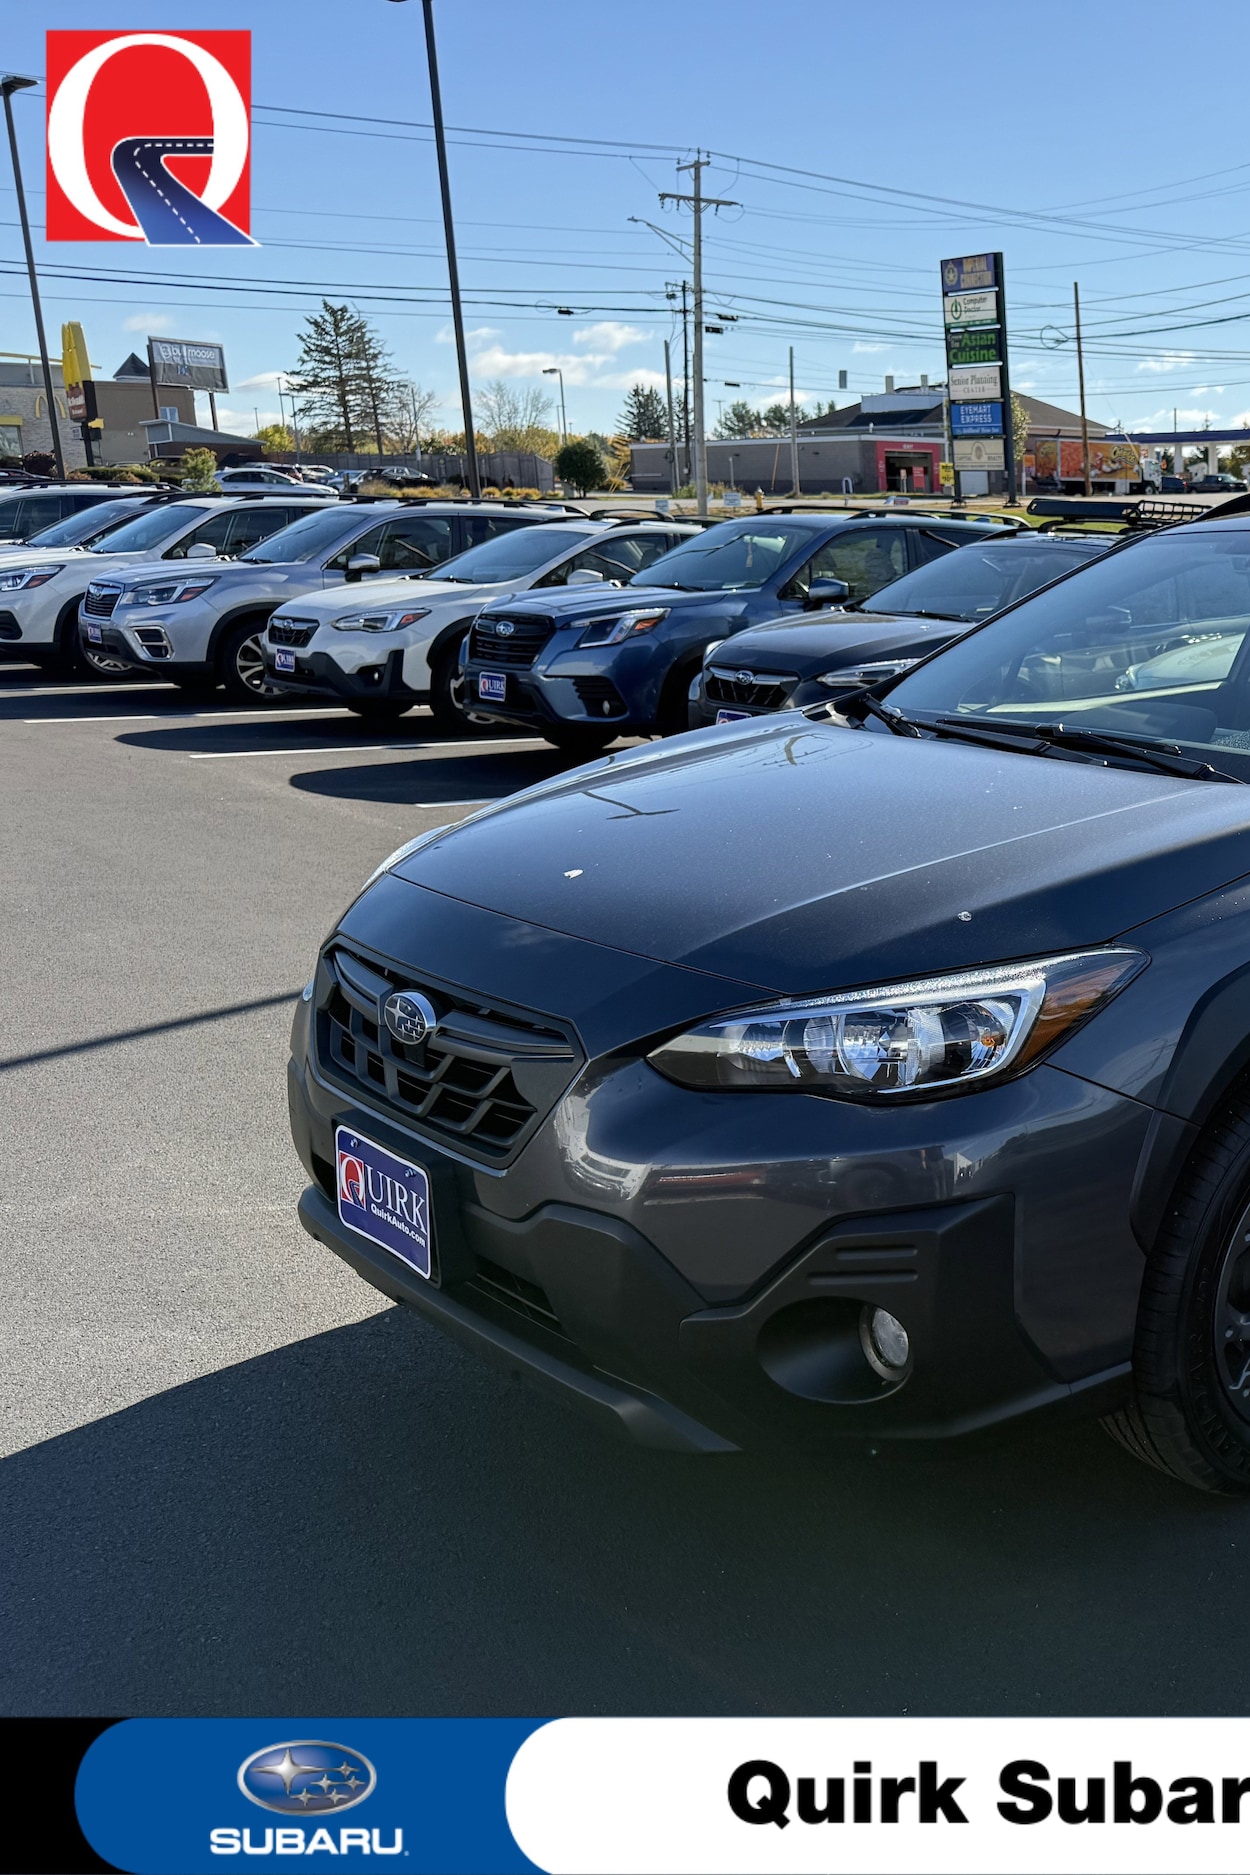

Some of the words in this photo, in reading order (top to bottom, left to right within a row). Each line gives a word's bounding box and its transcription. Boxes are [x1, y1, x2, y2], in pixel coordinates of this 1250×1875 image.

[961, 333, 996, 347] Asian
[188, 349, 215, 360] moose
[949, 348, 996, 362] Cuisine
[951, 376, 970, 386] Senior
[970, 374, 998, 387] Planning
[960, 404, 992, 415] EYEMART
[961, 414, 993, 424] EXPRESS
[340, 1155, 427, 1235] QUIRK
[370, 1203, 426, 1248] QuirkAuto.com
